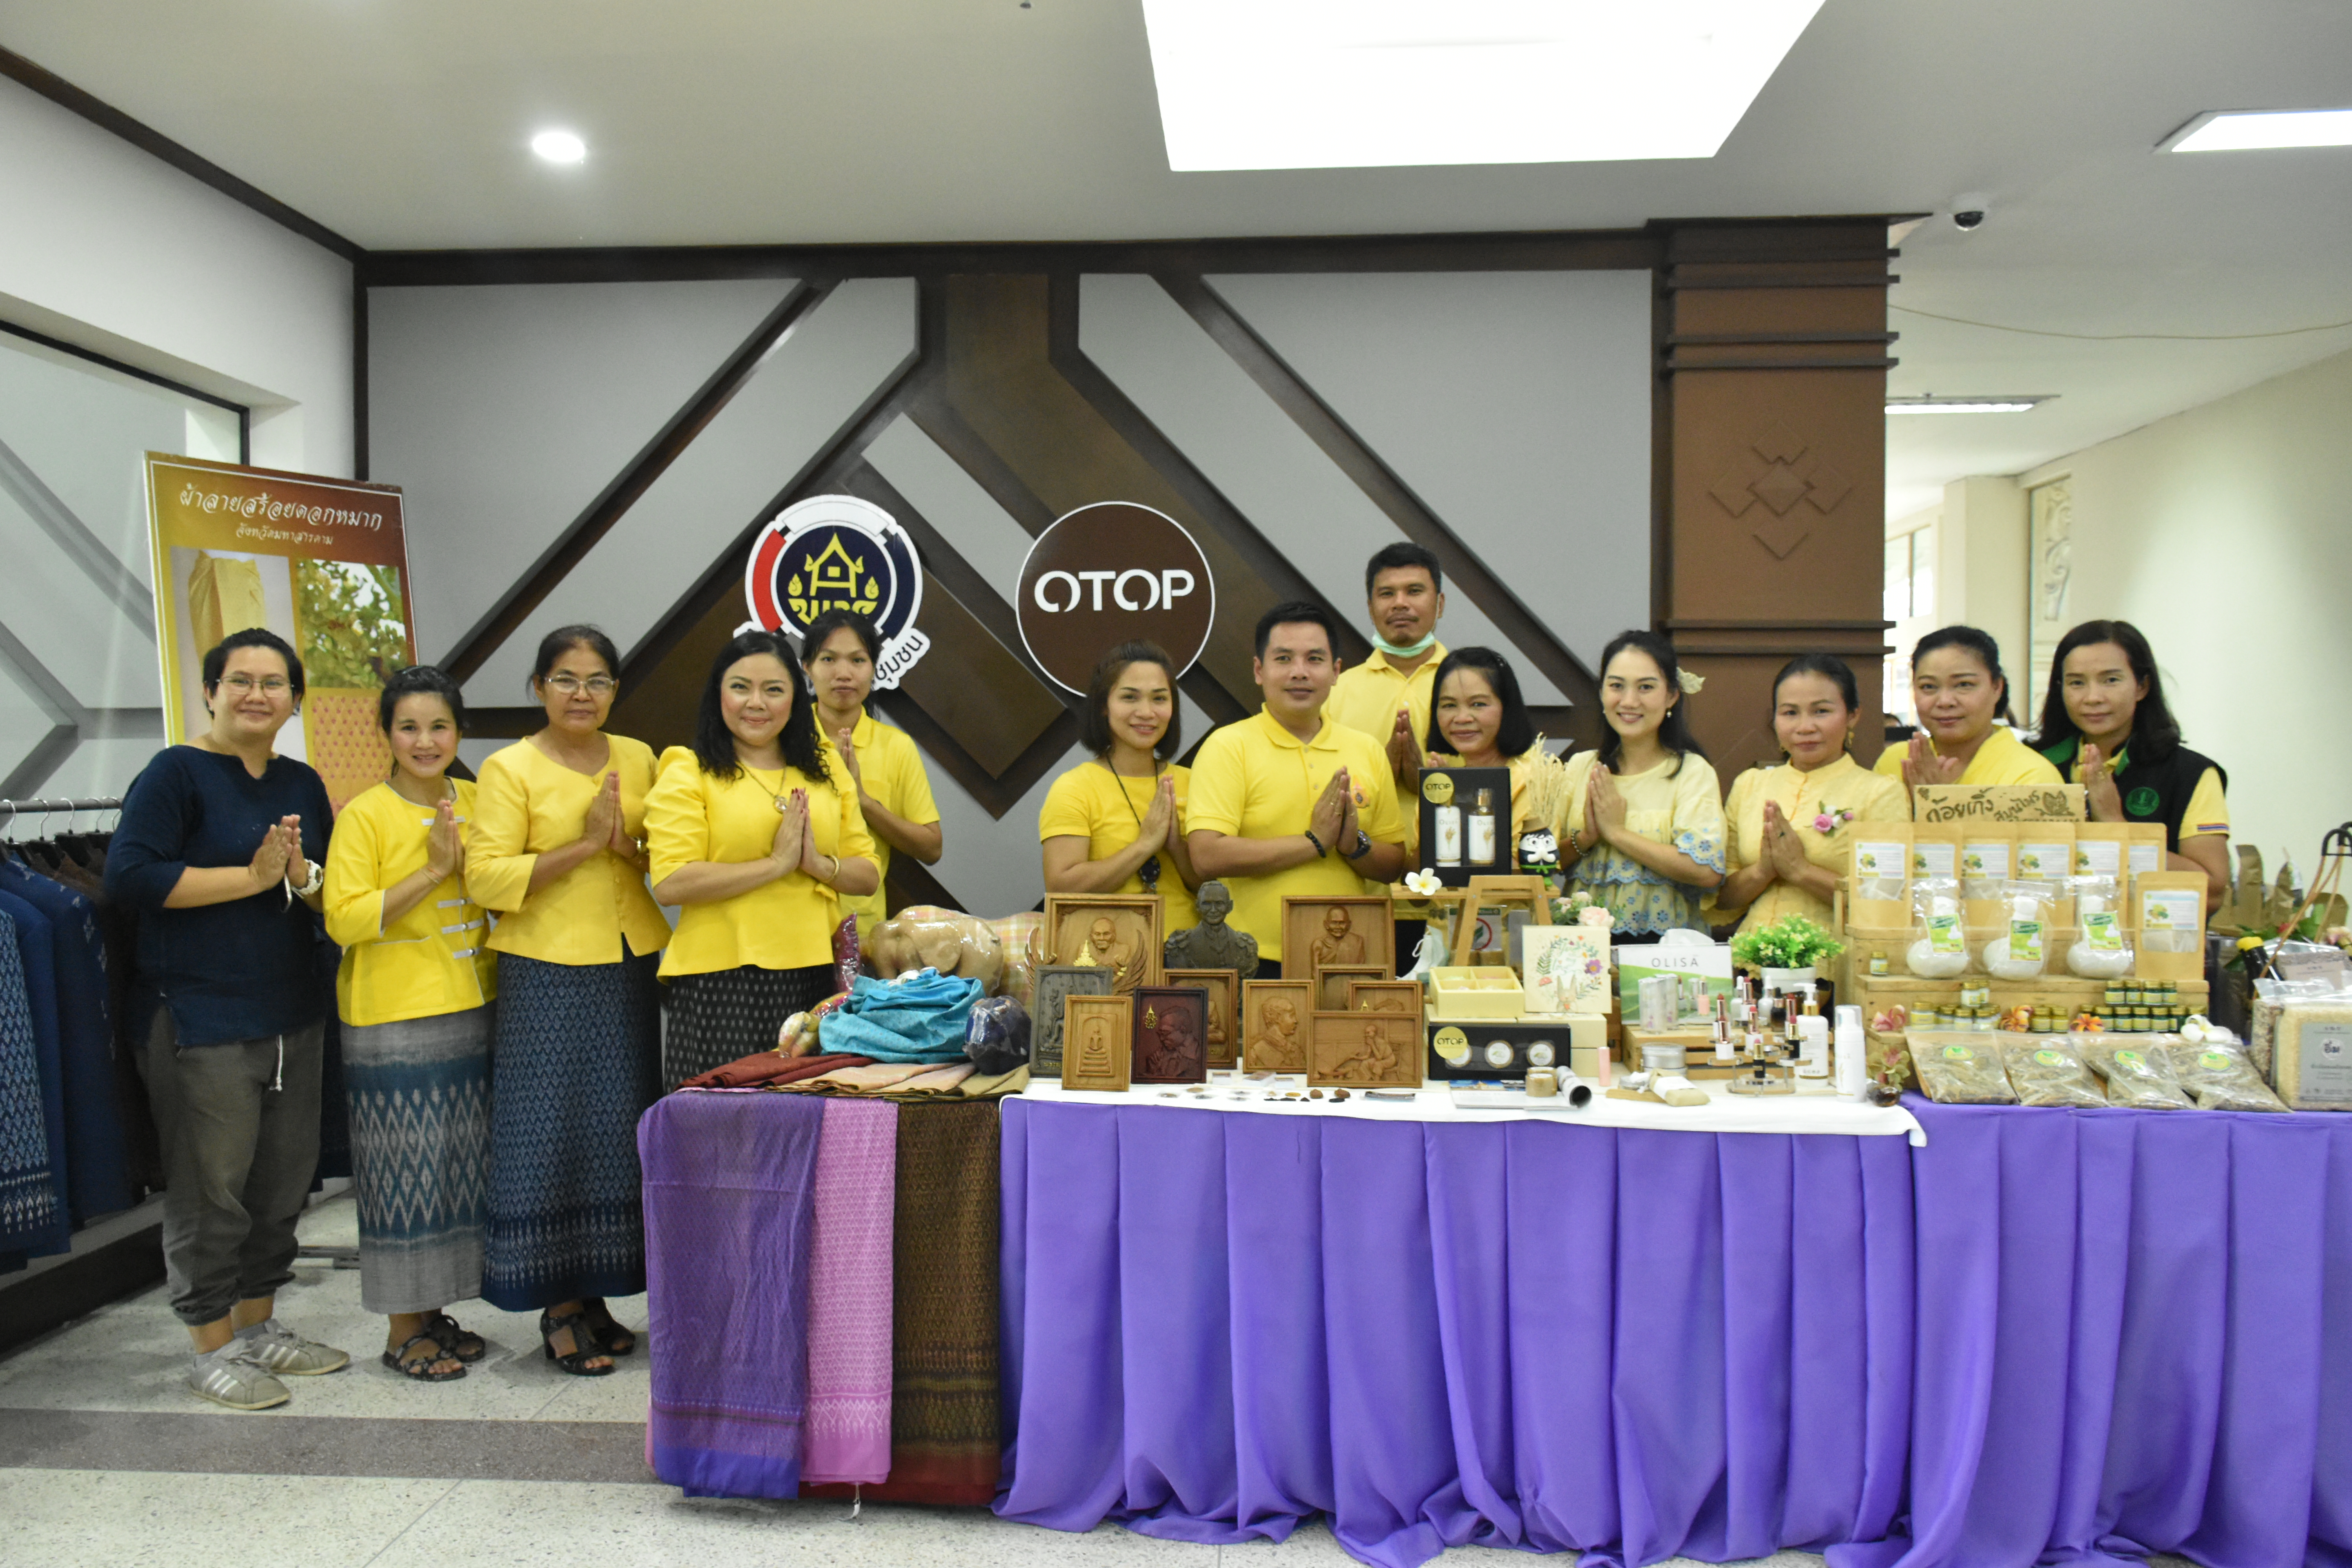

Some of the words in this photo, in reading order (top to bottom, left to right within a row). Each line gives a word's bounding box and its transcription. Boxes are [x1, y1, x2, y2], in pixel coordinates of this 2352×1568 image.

[180, 483, 383, 531] ผ้าลายสร้อยดอกหมาก
[236, 523, 334, 545] จังหวัดมหาสารคาม
[1034, 569, 1194, 612] OTOP
